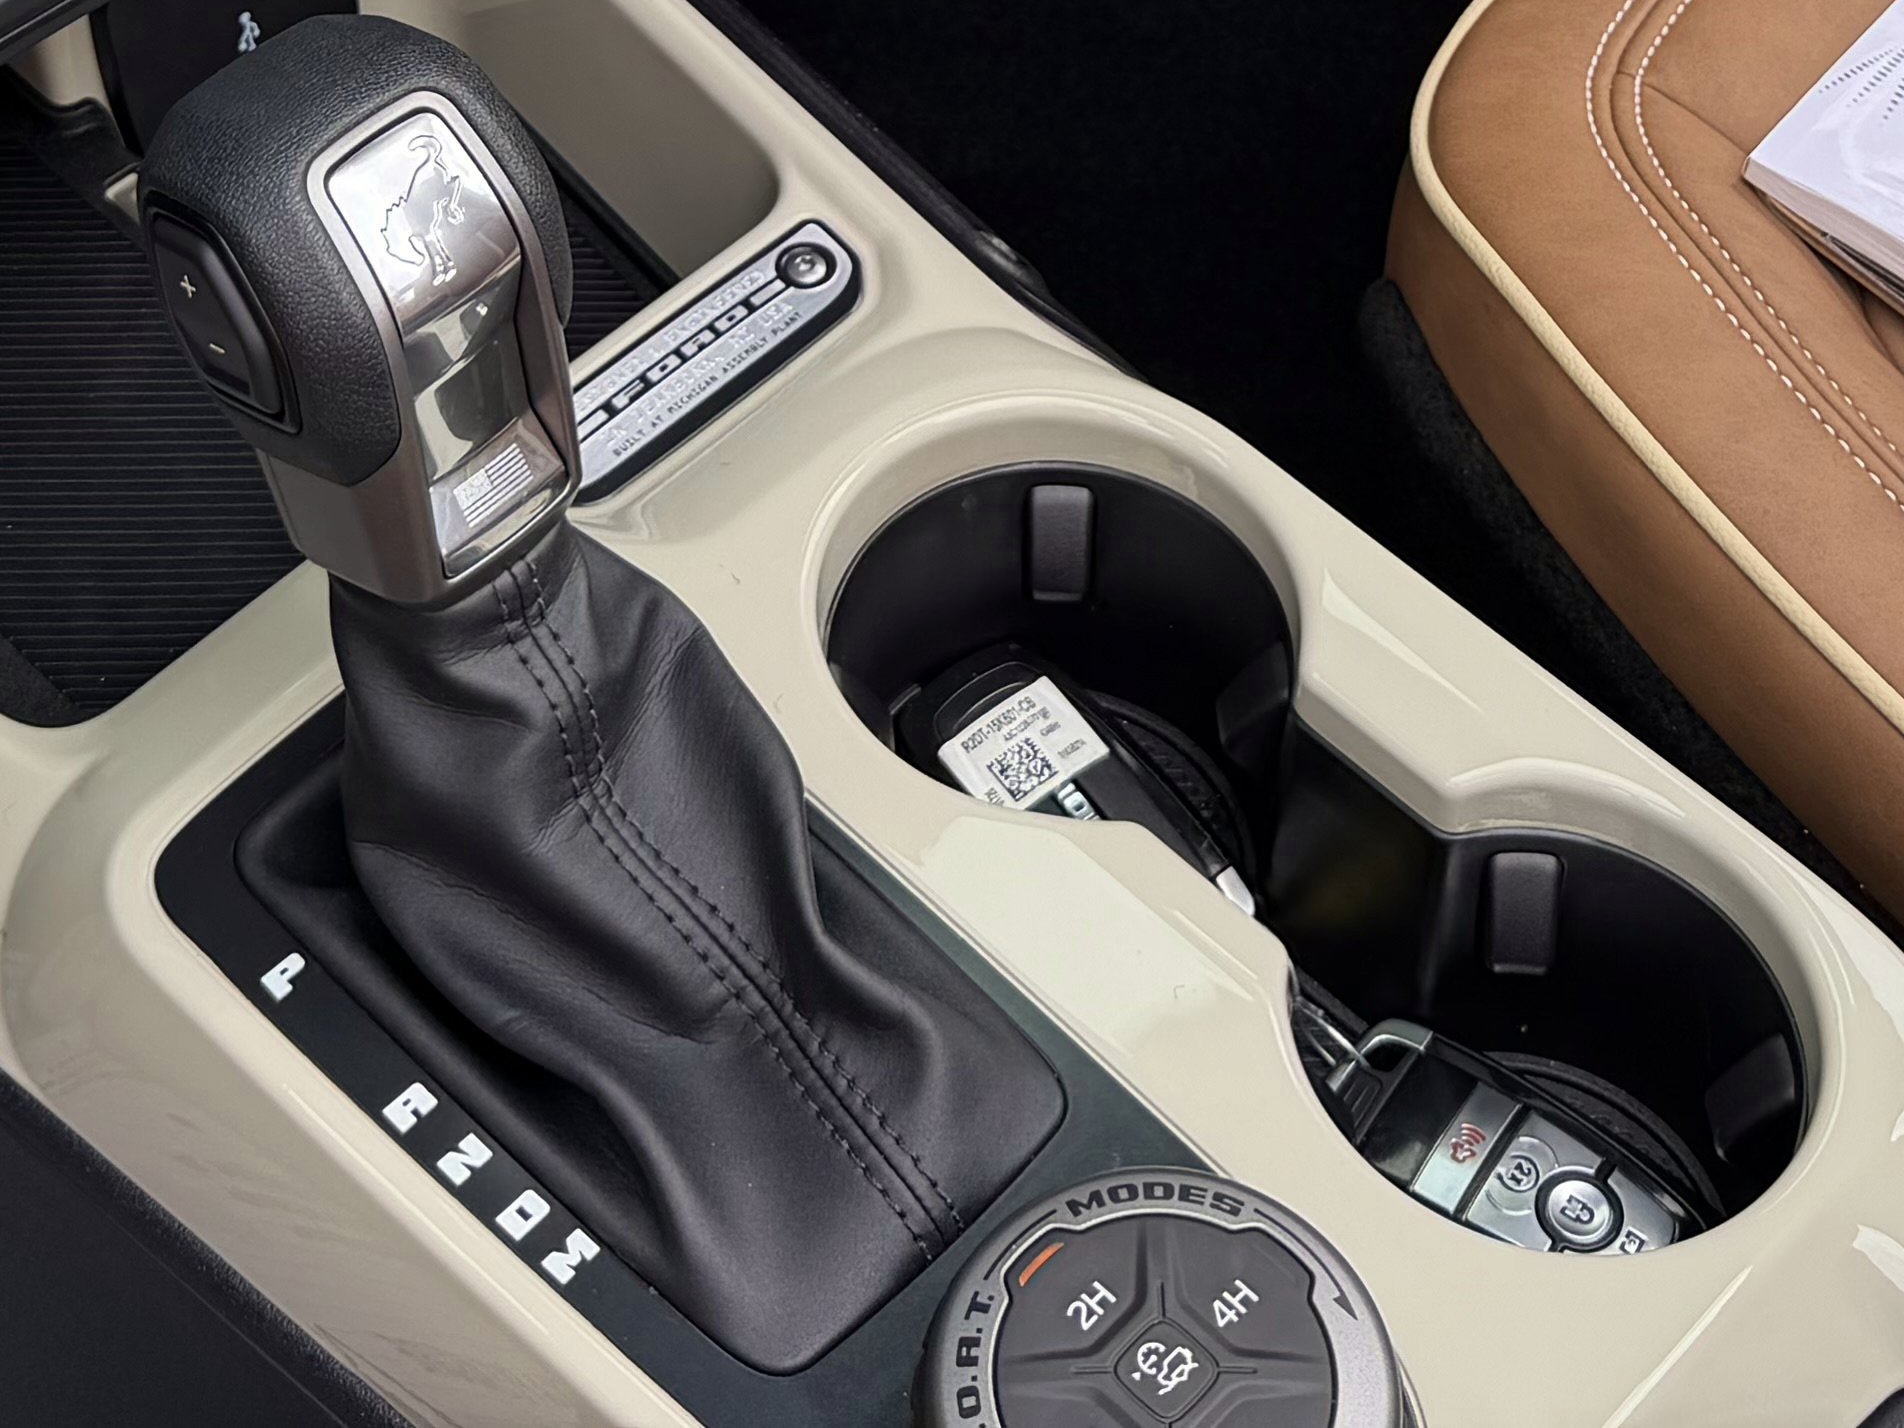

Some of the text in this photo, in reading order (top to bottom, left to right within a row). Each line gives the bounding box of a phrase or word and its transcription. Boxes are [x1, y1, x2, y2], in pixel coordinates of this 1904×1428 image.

[761, 300, 794, 327] USA
[612, 304, 749, 410] FORD
[613, 311, 803, 457] BUILT AT MICHIGAN ASSEMBLY PLANT
[260, 952, 601, 1285] P R N D M
[1065, 1180, 1247, 1218] MODES
[1066, 1279, 1118, 1331] 2H
[1211, 1278, 1261, 1329] 4H
